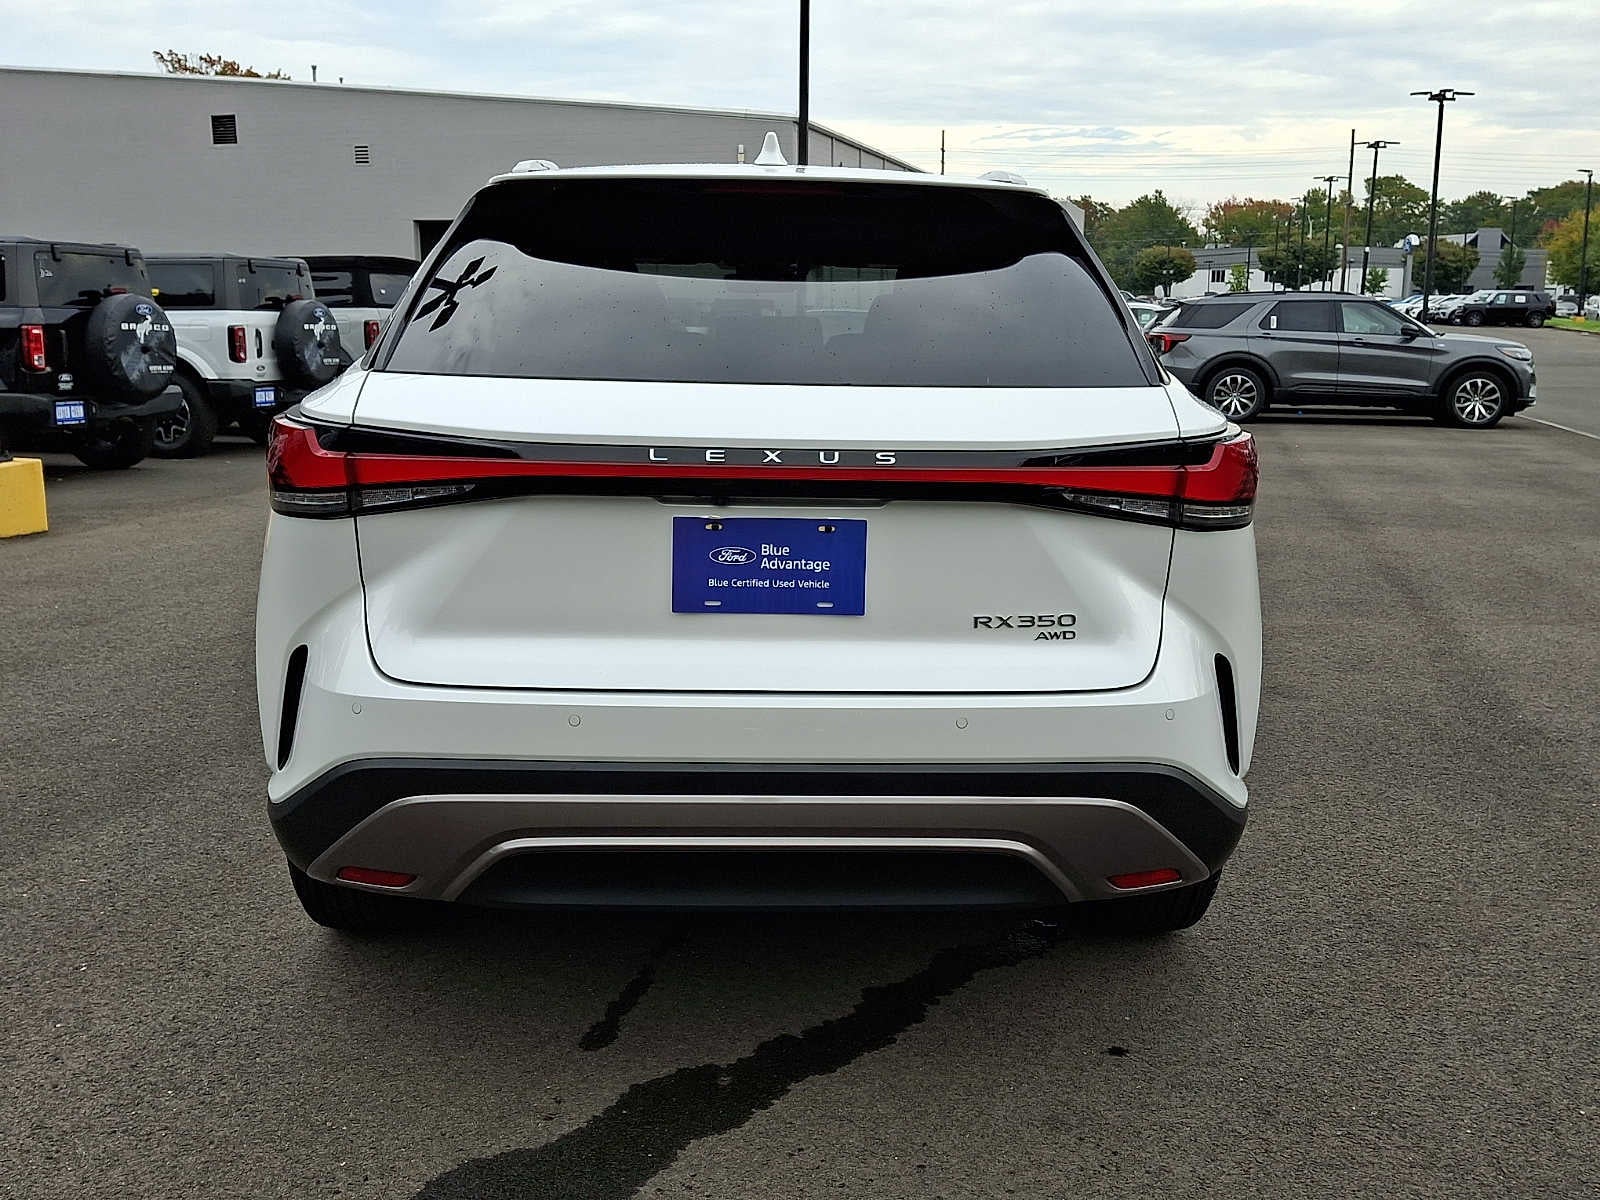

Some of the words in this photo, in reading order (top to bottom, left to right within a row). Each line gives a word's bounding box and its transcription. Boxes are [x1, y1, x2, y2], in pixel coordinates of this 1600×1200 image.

[121, 322, 169, 331] BRCO
[649, 448, 896, 465] LEXUS
[718, 549, 748, 563] Ford
[761, 543, 790, 556] Blue
[760, 557, 831, 572] Advantage
[708, 578, 729, 587] Blue
[731, 578, 770, 588] Certified
[772, 579, 795, 588] Used
[798, 579, 830, 589] Vehicle
[973, 614, 1077, 629] RX350
[1034, 630, 1076, 641] AWD
